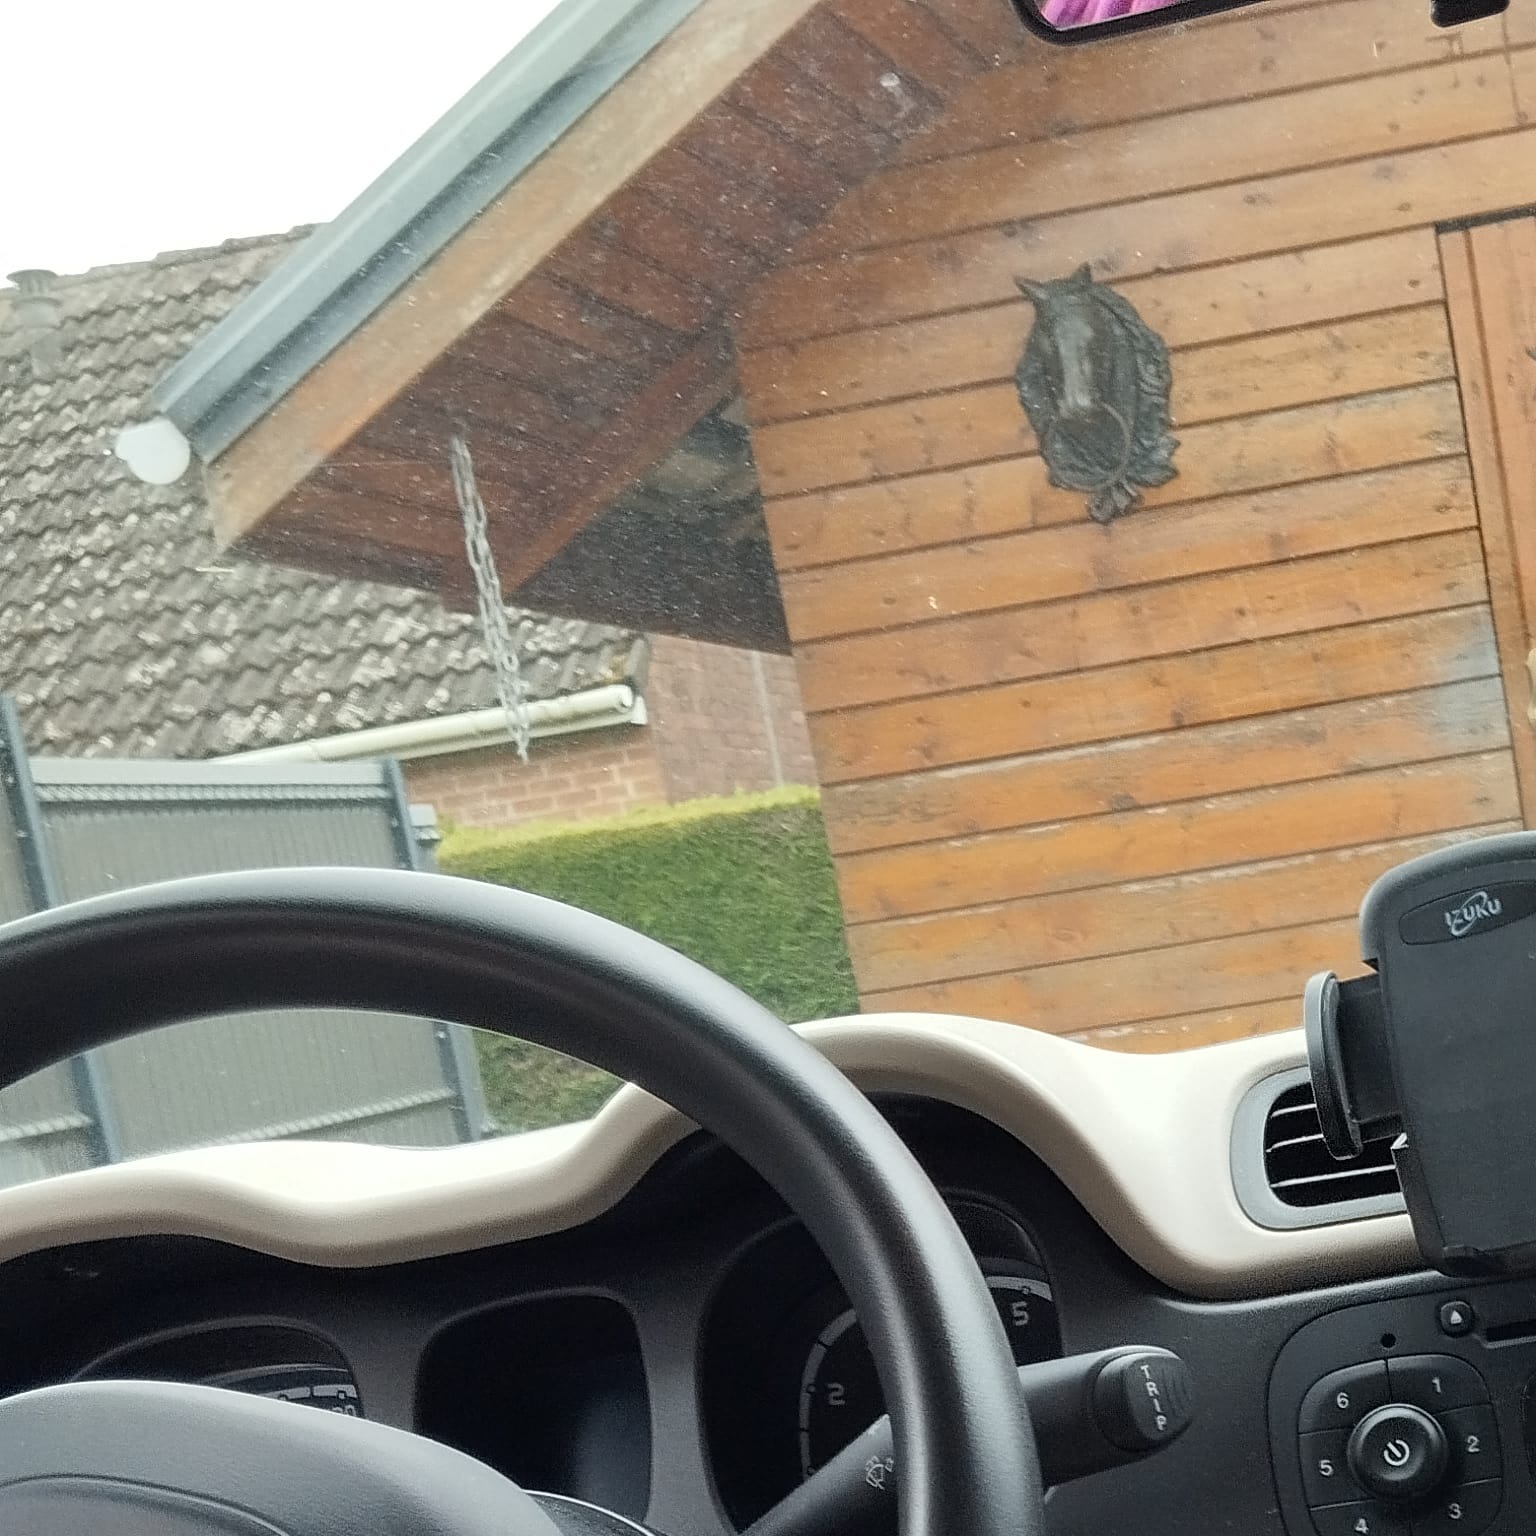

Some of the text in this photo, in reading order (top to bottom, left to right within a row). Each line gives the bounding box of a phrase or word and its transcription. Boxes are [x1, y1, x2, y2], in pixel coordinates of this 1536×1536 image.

[1011, 1301, 1030, 1327] 5
[826, 1382, 846, 1406] 2
[1431, 1376, 1443, 1394] 1
[1140, 1364, 1168, 1431] TRIP
[1336, 1391, 1350, 1409] 6
[1466, 1435, 1480, 1453] 2
[1319, 1459, 1334, 1477] 5
[1448, 1502, 1463, 1520] 3
[1354, 1517, 1369, 1535] 4
